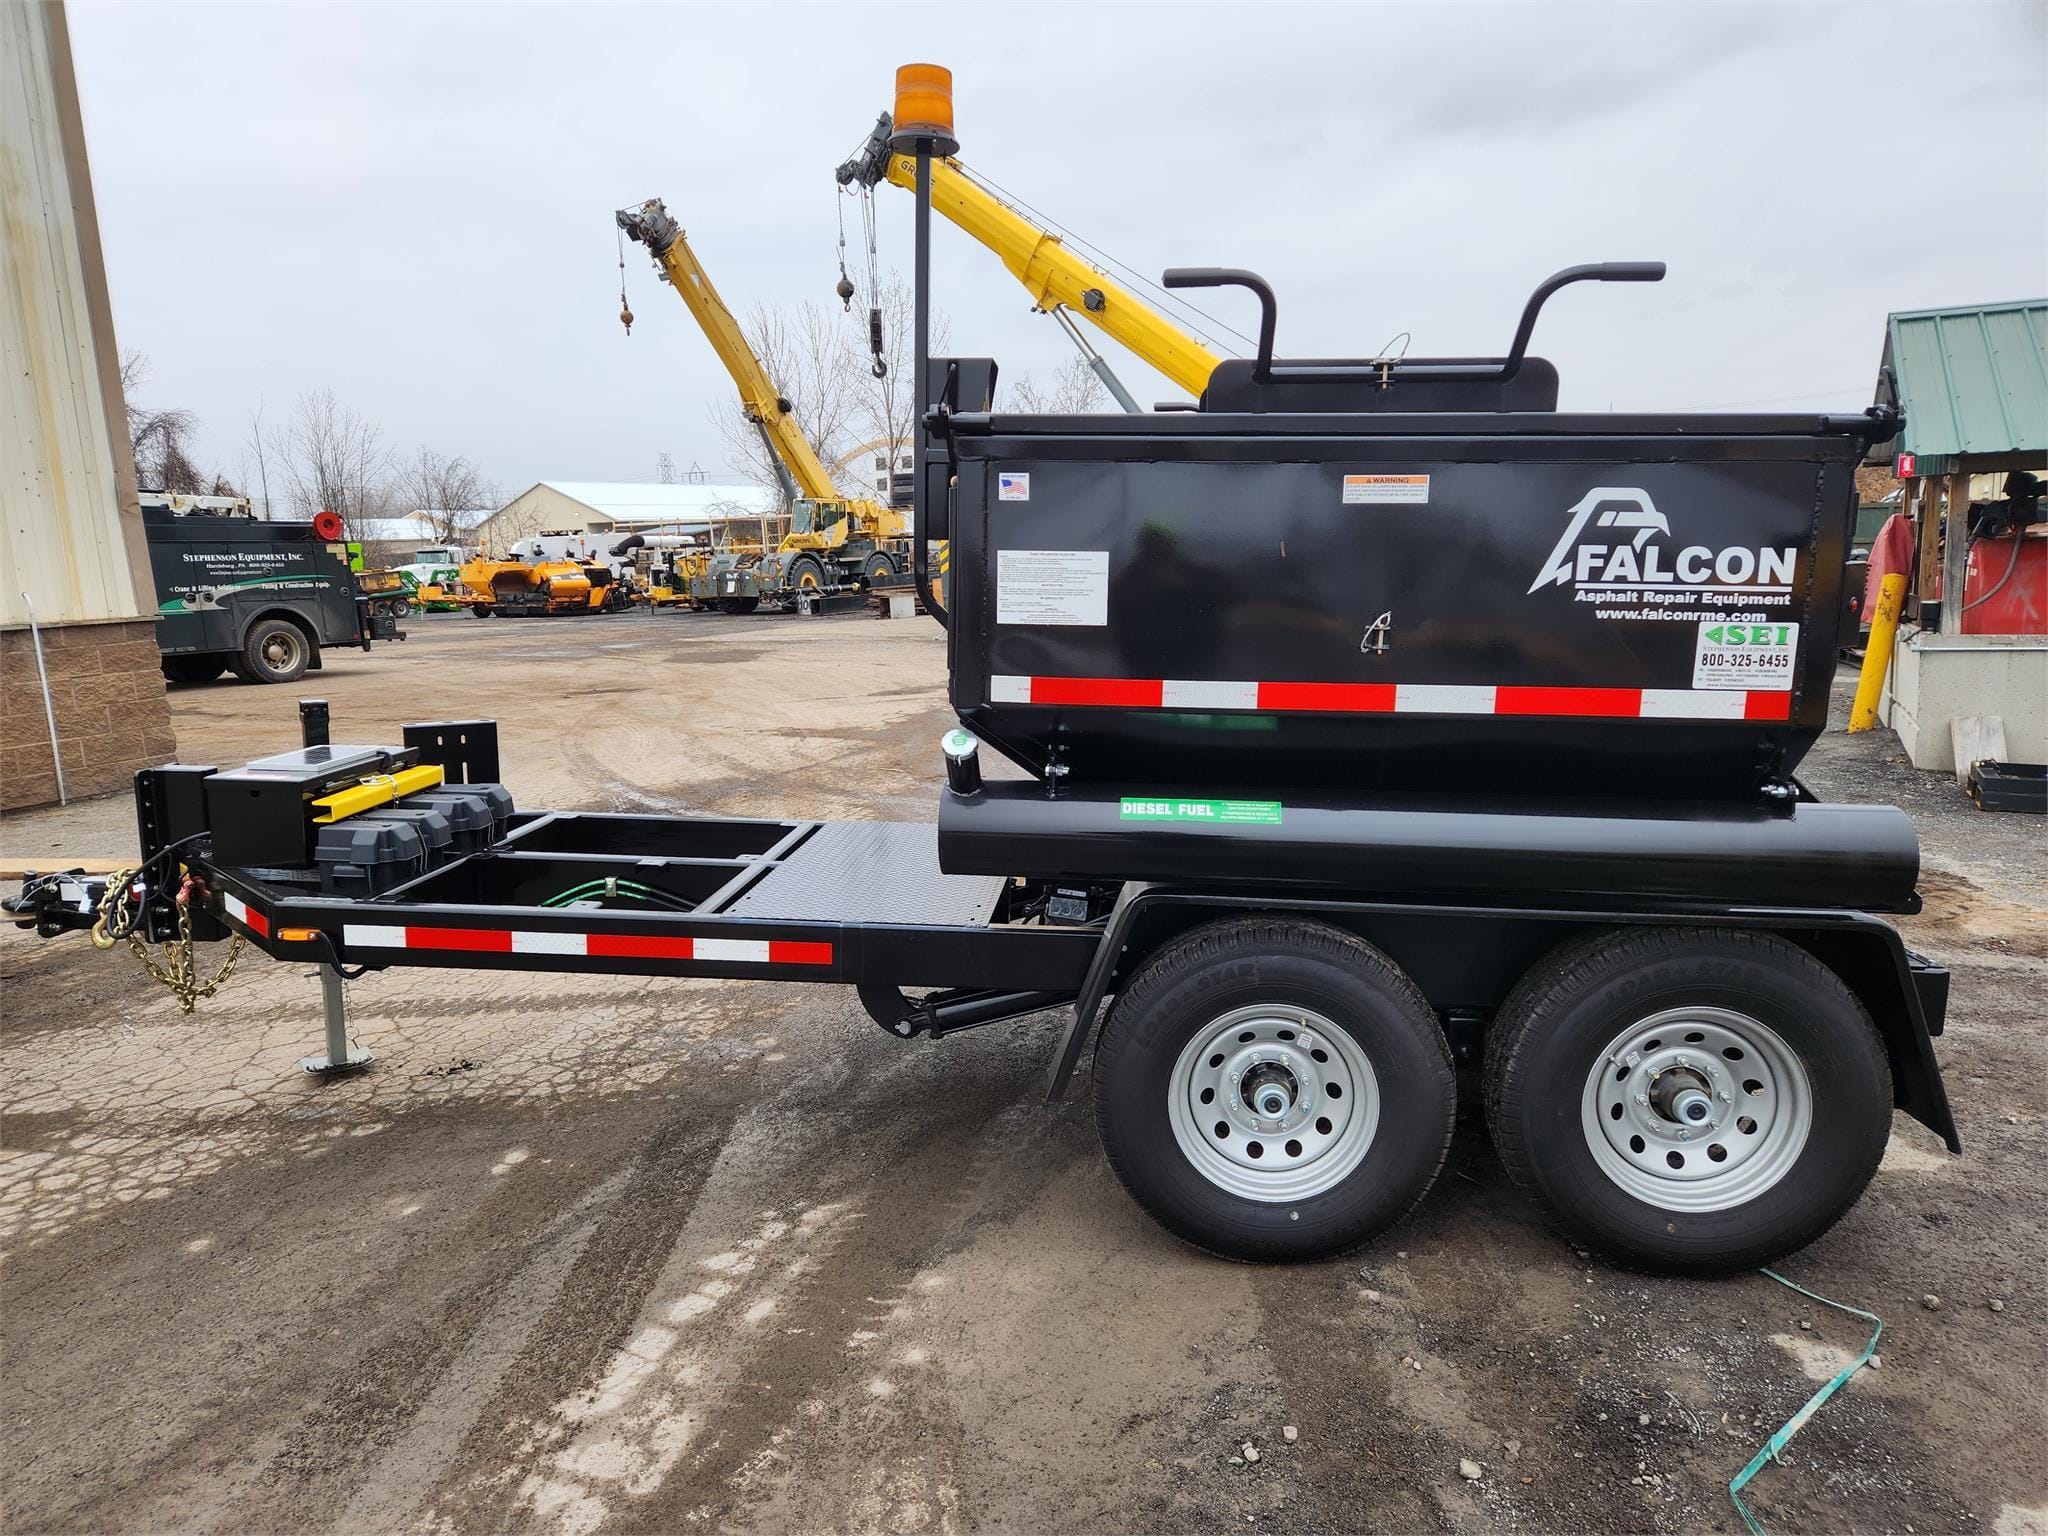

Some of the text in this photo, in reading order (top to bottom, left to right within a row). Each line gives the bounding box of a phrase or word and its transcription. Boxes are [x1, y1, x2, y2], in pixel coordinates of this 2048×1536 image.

[183, 552, 304, 562] STEPHENSON EQUIPMENT, INC.
[1575, 545, 1797, 585] FALCON
[1574, 590, 1791, 607] Asphalt Repair Equipment
[1595, 608, 1767, 622] www.falconrme.com
[1725, 625, 1790, 645] SEI
[1701, 653, 1789, 667] 800-325-6455
[1122, 802, 1173, 815] DIESEL
[1178, 803, 1214, 817] FUEL
